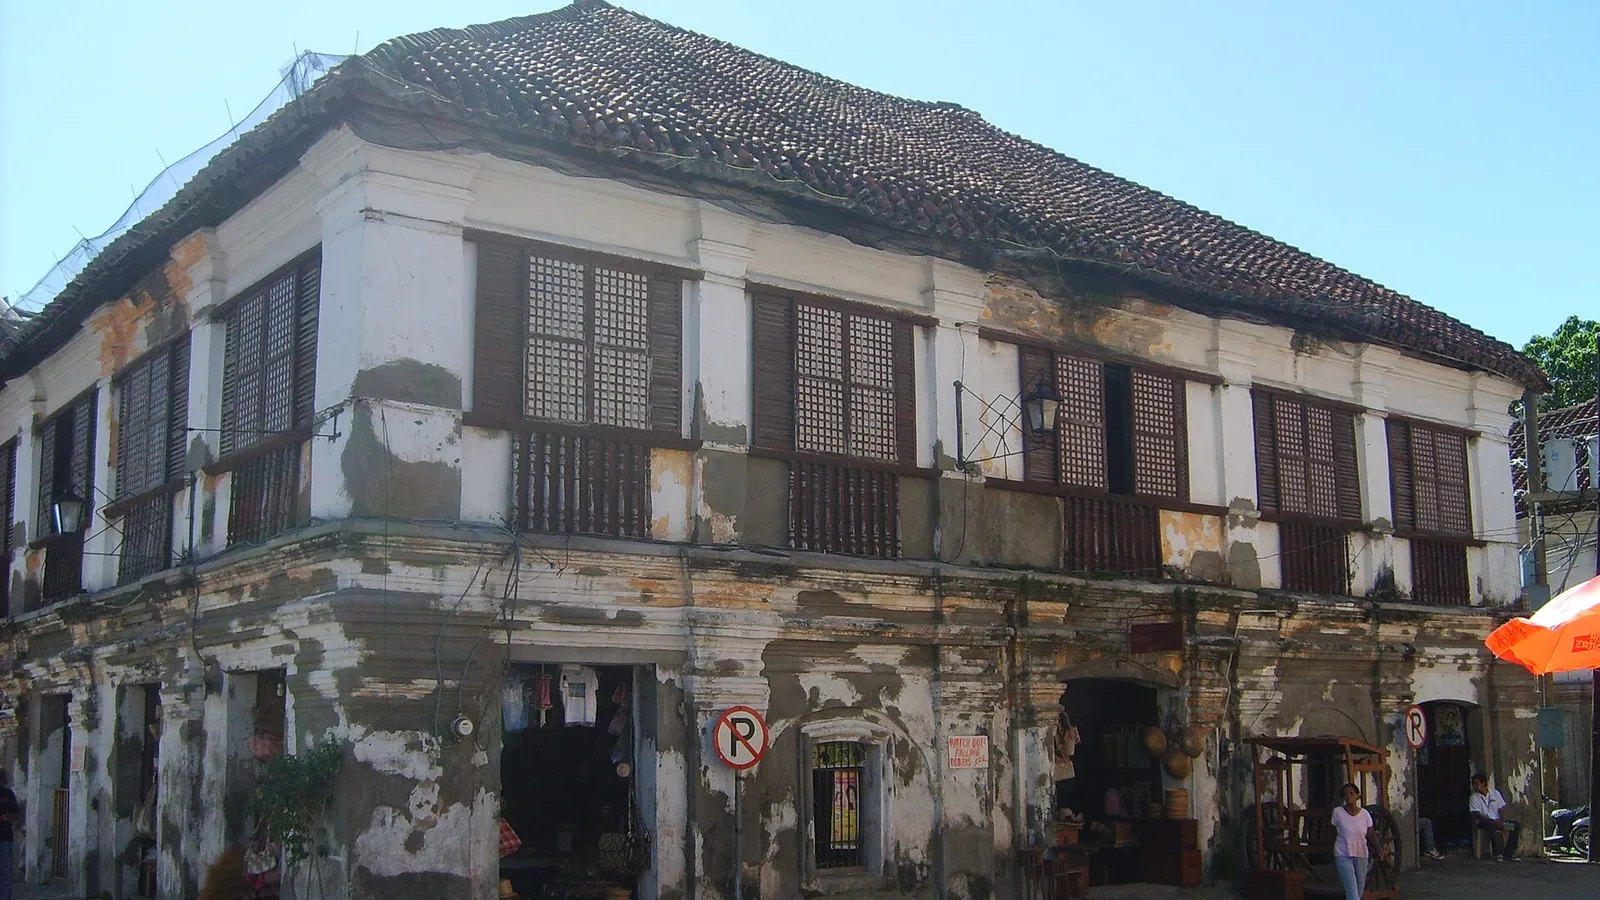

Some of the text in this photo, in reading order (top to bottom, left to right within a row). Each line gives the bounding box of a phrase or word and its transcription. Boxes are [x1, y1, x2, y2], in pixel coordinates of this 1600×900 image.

[1411, 712, 1421, 742] P
[731, 717, 755, 758] P
[951, 757, 971, 767] DEBRIS
[955, 748, 980, 758] FALLING
